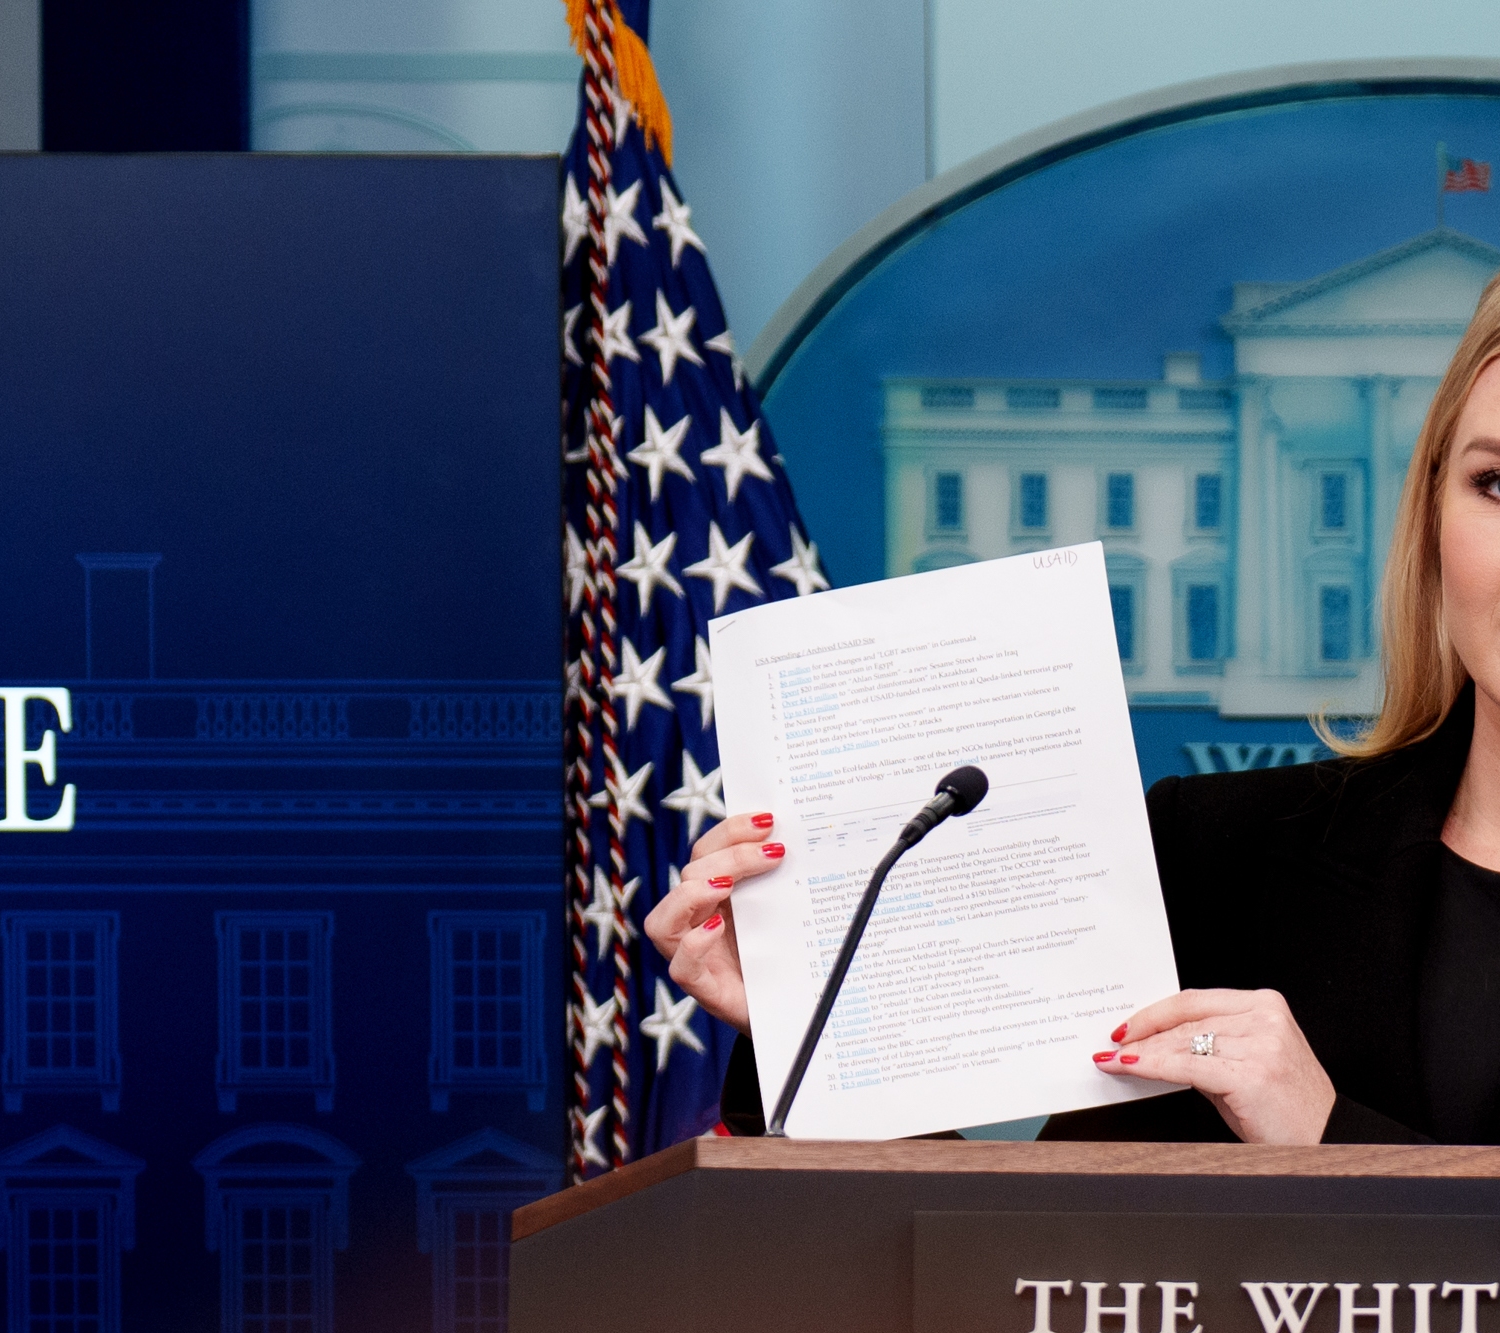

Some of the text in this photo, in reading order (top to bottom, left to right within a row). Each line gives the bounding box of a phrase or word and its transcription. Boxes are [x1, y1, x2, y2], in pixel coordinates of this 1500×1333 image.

[1033, 550, 1078, 569] USAID
[789, 677, 813, 686] million
[821, 670, 838, 680] fund
[838, 667, 866, 676] tourism
[874, 661, 895, 671] Egypt
[803, 707, 816, 717] $10
[816, 704, 840, 713] million
[840, 698, 862, 708] worth
[870, 687, 921, 703] USAID-funded
[922, 684, 942, 694] meals
[942, 681, 960, 690] went
[976, 669, 1023, 685] Qaeda-linked
[1023, 666, 1052, 676] terrorist
[1052, 662, 1074, 673] group
[787, 740, 806, 750] Israel
[806, 739, 819, 748] just
[831, 734, 848, 742] days
[848, 730, 871, 739] before
[919, 716, 943, 726] attacks
[788, 749, 820, 761] Awarded
[820, 746, 842, 757] nearly
[842, 743, 856, 753] $25
[856, 740, 881, 749] million
[889, 733, 917, 743] Deloitte
[925, 726, 955, 739] promote
[955, 723, 976, 734] green
[976, 715, 1025, 729] transportation
[1033, 708, 1062, 719] Georgia
[1062, 705, 1077, 715] (the
[796, 718, 818, 727] Nusra
[818, 714, 837, 723] Front
[807, 876, 821, 886] $20
[821, 873, 846, 882] million
[918, 853, 966, 866] Transparency
[967, 848, 981, 857] and
[982, 841, 1032, 855] Accountability
[1032, 835, 1061, 846] through
[809, 882, 854, 895] Investigative
[890, 871, 921, 883] program
[920, 865, 943, 876] which
[943, 862, 961, 872] used
[973, 854, 1010, 867] Organized
[1010, 852, 1033, 860] Crime
[1033, 847, 1048, 856] and
[1047, 842, 1088, 855] Corruption
[811, 894, 847, 906] Reporting
[923, 873, 972, 886] implementing
[971, 868, 1000, 879] partner.
[1000, 864, 1014, 872] The
[1014, 859, 1042, 870] OCCRP
[1058, 853, 1076, 863] cited
[813, 907, 833, 916] times
[902, 892, 922, 900] letter
[922, 888, 938, 897] that
[970, 877, 1008, 889] Russiagate
[1008, 868, 1057, 882] impeachment.
[886, 957, 912, 967] African
[912, 950, 948, 962] Methodist
[948, 943, 983, 956] Episcopal
[982, 939, 1010, 950] Church
[1009, 935, 1035, 945] Service
[1036, 931, 1050, 941] and
[1050, 924, 1097, 939] Development
[878, 989, 908, 1001] promote
[908, 984, 929, 994] LGBT
[930, 980, 963, 991] advocacy
[972, 974, 1002, 983] Jamaica.
[843, 1028, 869, 1037] million
[877, 1021, 907, 1033] promote
[933, 1012, 962, 1022] equality
[962, 1006, 992, 1017] through
[1066, 987, 1106, 999] developing
[1105, 984, 1125, 992] Latin
[841, 1081, 857, 1091] $2.5
[857, 1078, 882, 1087] million
[891, 1071, 921, 1083] promote
[970, 1058, 1002, 1067] Vietnam.
